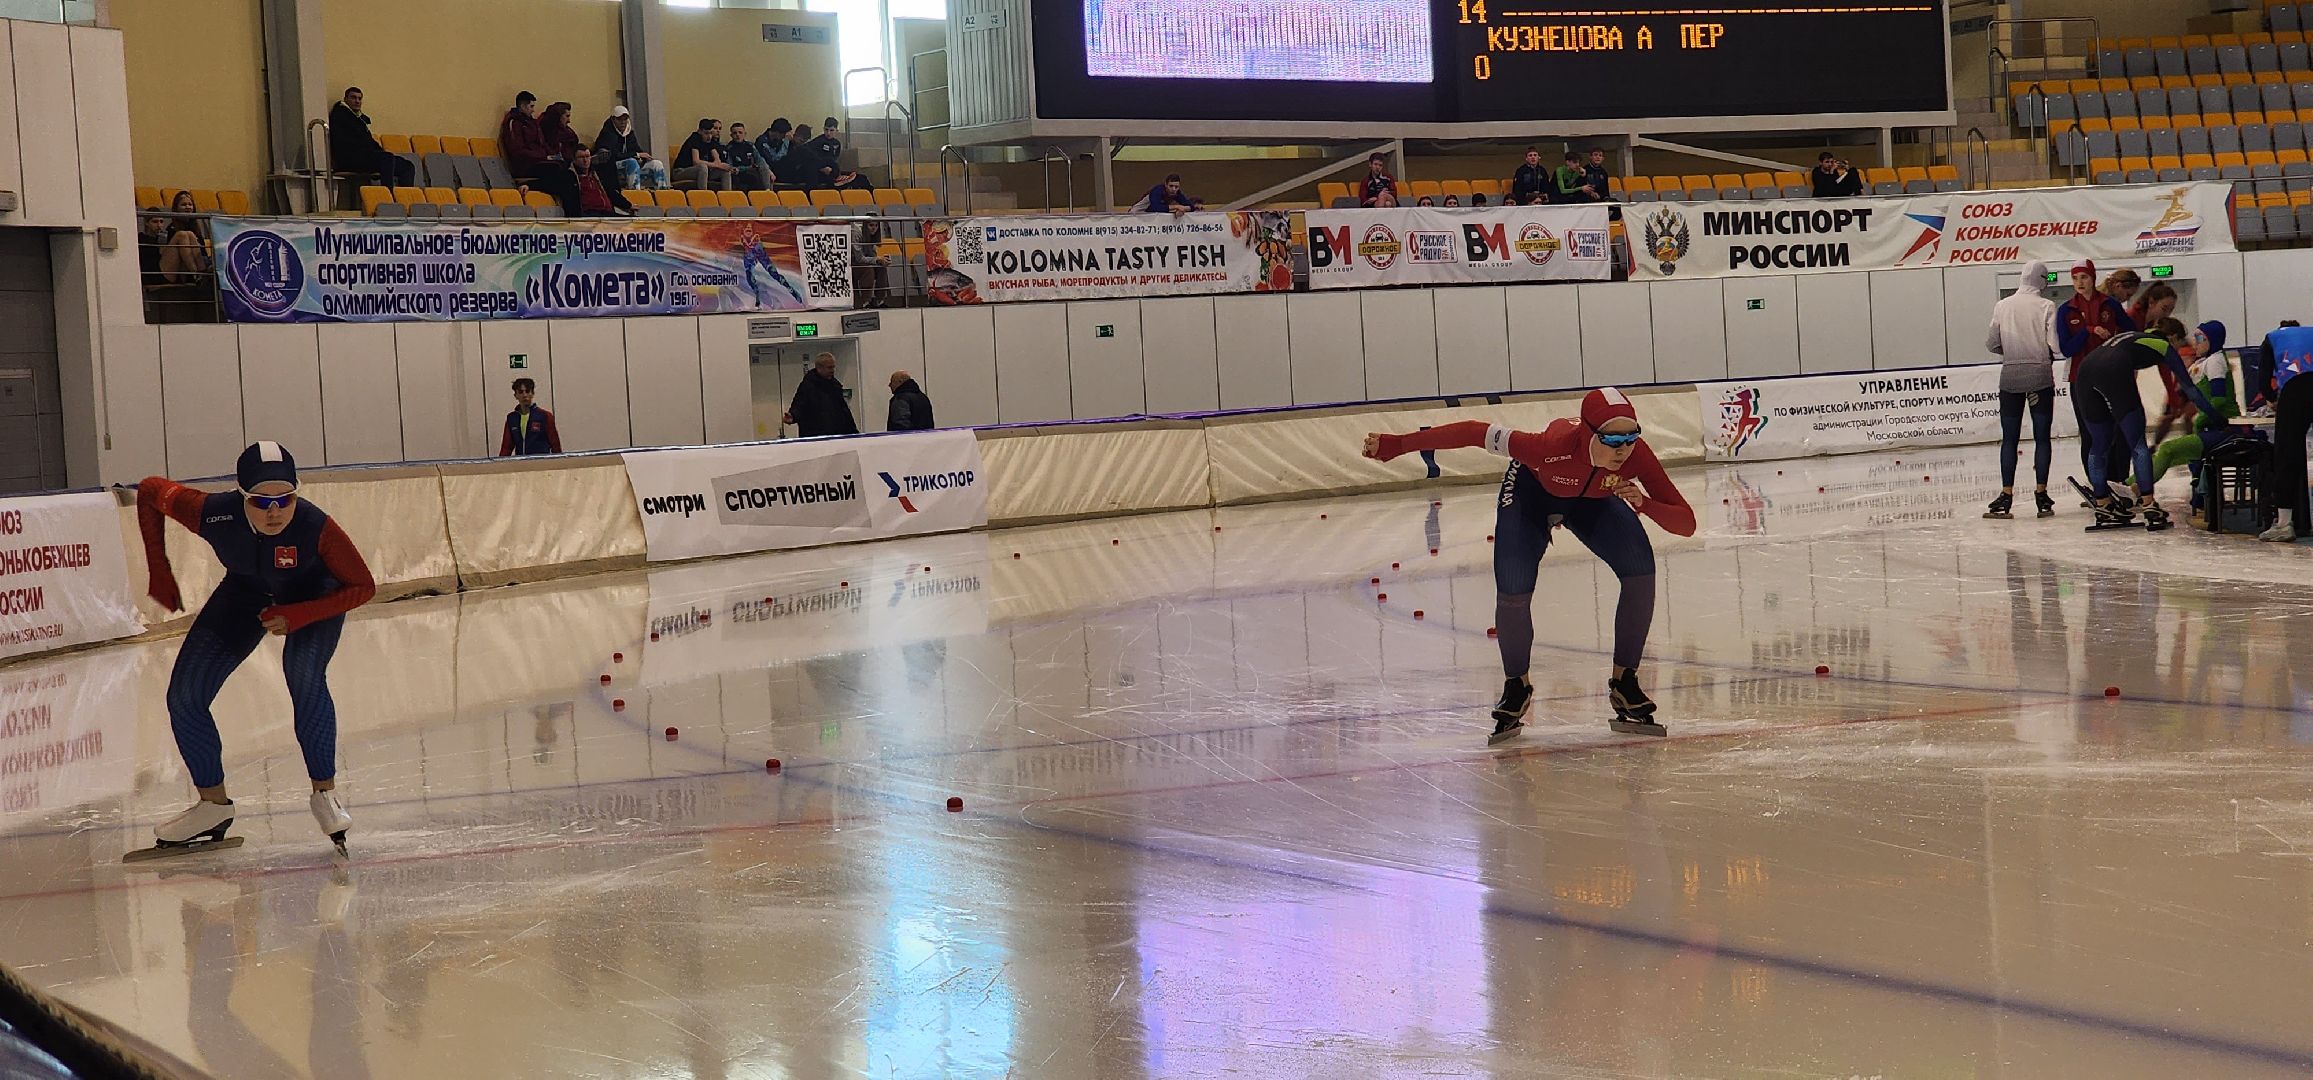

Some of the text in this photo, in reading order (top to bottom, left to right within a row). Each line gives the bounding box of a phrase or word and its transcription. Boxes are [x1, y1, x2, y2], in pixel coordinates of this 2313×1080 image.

[1458, 0, 1487, 23] 14
[1488, 24, 1724, 52] КУЗНЕЦОВА А ПЕР
[1703, 208, 1873, 236] МИНСПОРТ
[1962, 203, 2014, 219] СОЮЗ
[999, 228, 1040, 239] ДОСТАВКА
[1042, 227, 1054, 237] ПО
[1056, 226, 1093, 237] КОЛОМНЕ
[1955, 221, 2099, 241] КОНЬКОБЕЖЦЕВ
[314, 227, 665, 261] Муниципальное бюджетное учреждение
[1949, 246, 2020, 264] РОССИИ
[986, 244, 1226, 275] KOLOMNA TASTY FISH
[1729, 243, 1850, 270] РОССИИ
[318, 263, 475, 290] спортивная школа
[525, 263, 665, 309] «Комета»
[671, 271, 738, 286] Год основания
[989, 272, 1228, 290] ВКУСНАЯ РЫБА, МОРЕПРОДУКТЫ И ДРУГИЕ ДЕЛИКАТЕСЫ
[322, 287, 518, 318] олимпийского резерва
[670, 291, 690, 306] 1961
[1860, 376, 1949, 395] УПРАВЛЕНИЕ
[1773, 408, 1788, 417] ПО
[1789, 401, 1851, 416] ФИЗИЧЕСКОЙ
[1852, 399, 1899, 412] КУЛЬТУРЕ,
[1899, 396, 1935, 408] СПОРТУ
[1937, 396, 1944, 405] И
[1813, 417, 1883, 431] администрации
[1885, 411, 1936, 427] Городского
[1939, 410, 1969, 423] округа
[1866, 426, 1964, 442] Московской области
[725, 474, 856, 512] СПОРТИВНЫЙ
[903, 470, 975, 493] ТРИКОЛОР
[643, 493, 706, 519] смотри
[0, 509, 23, 535] ЮЗ
